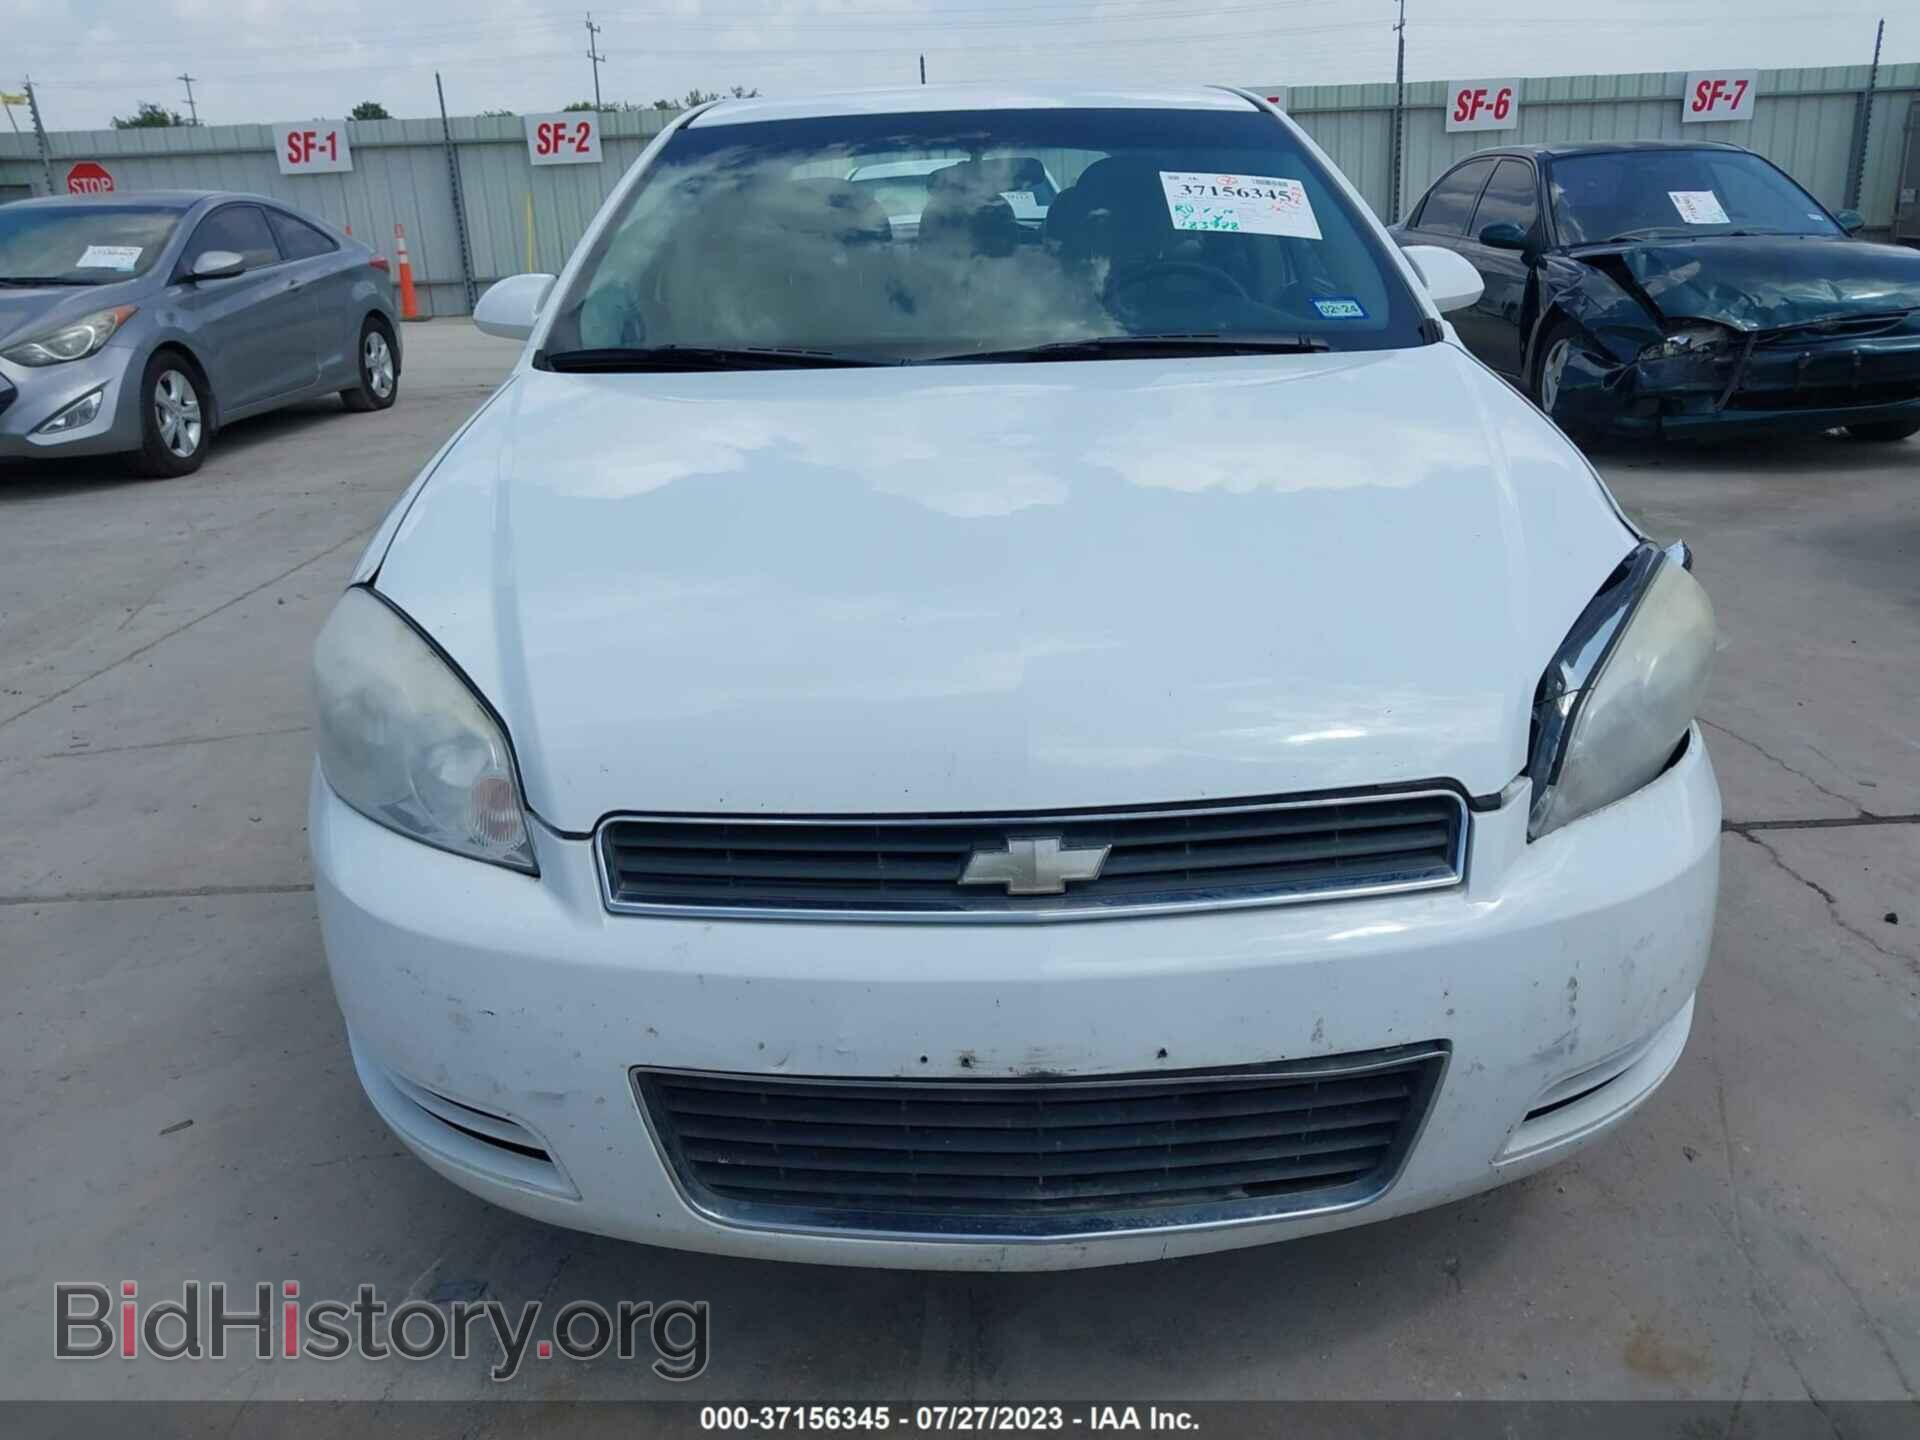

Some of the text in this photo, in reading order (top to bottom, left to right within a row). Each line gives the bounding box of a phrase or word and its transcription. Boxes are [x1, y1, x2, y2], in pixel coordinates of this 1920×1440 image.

[1454, 88, 1512, 122] SF-6
[1692, 79, 1748, 113] SF-7
[287, 131, 337, 164] SF-1
[536, 121, 591, 155] SF-2
[70, 177, 112, 194] STOP
[1179, 183, 1292, 202] 37156345
